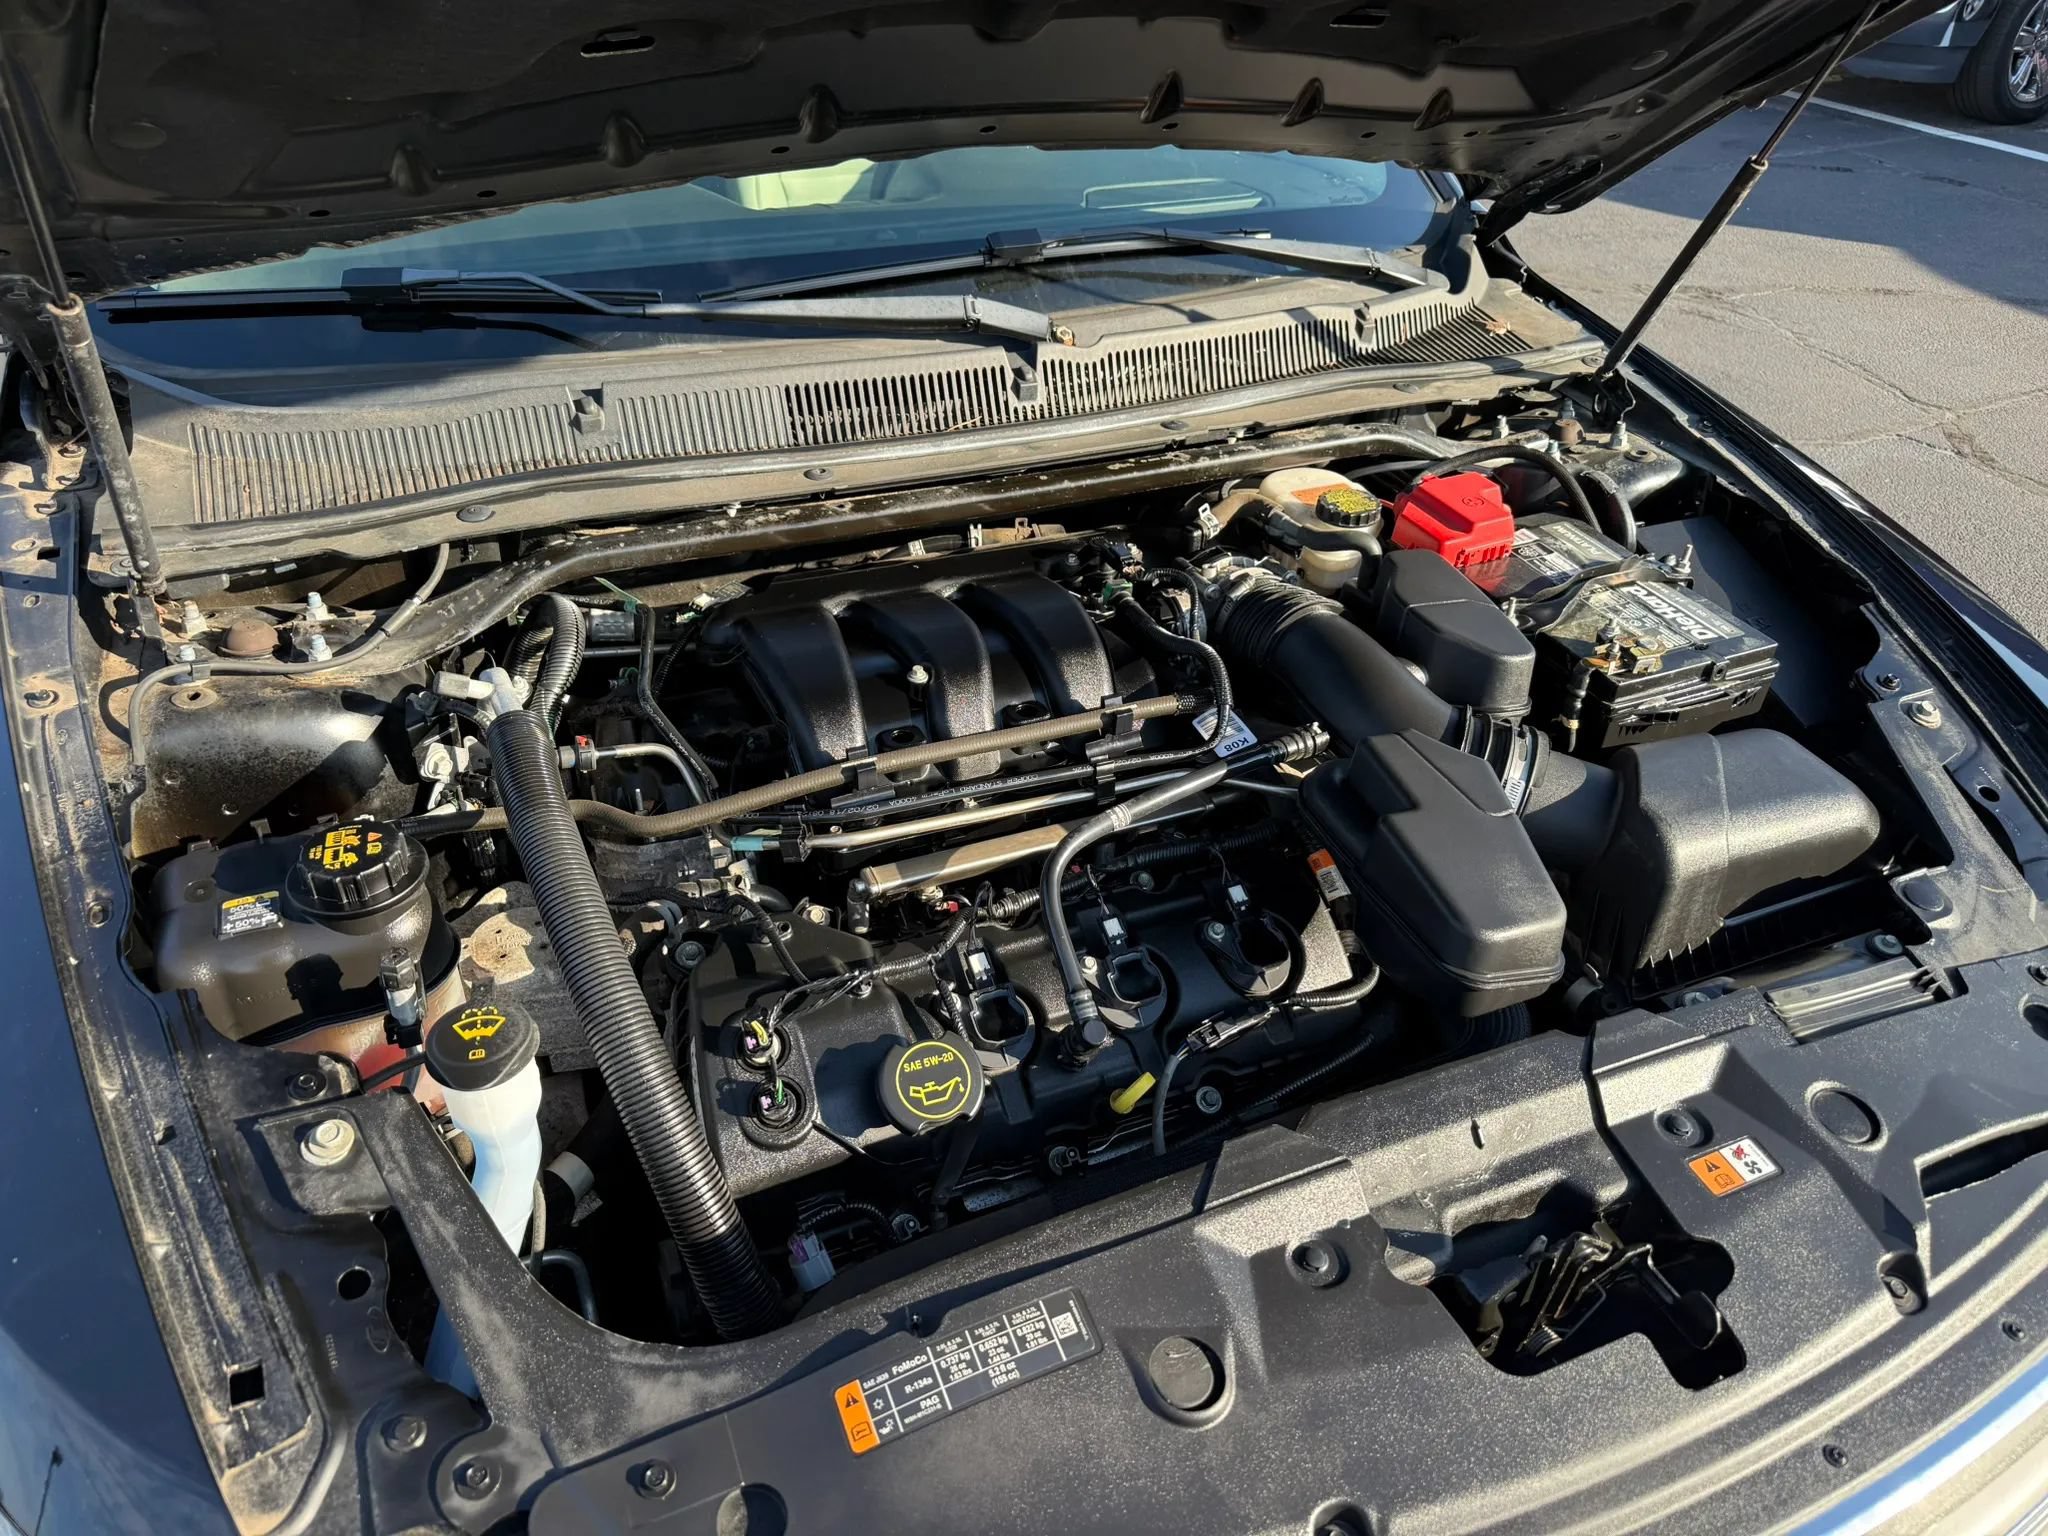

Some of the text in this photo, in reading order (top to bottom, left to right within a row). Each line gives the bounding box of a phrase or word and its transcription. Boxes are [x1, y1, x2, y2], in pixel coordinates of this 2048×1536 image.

[1621, 583, 1719, 640] DieHard
[1223, 736, 1249, 753] K08
[1006, 773, 1039, 785] COOPER
[959, 779, 1003, 794] STANDARD
[888, 796, 918, 807] 4000A
[828, 803, 880, 816] 02/02/18
[235, 917, 261, 929] 50%
[903, 1051, 955, 1073] SAE 5W-20
[1015, 1320, 1046, 1337] 0.822 kg
[1033, 1330, 1042, 1338] oz
[978, 1335, 1008, 1352] 0.652 kg
[1037, 1336, 1049, 1344] lbs
[996, 1345, 1005, 1353] oz
[1000, 1352, 1011, 1360] lbs
[891, 1354, 928, 1375] FoMoCo
[940, 1351, 971, 1368] 0.737 kg
[949, 1361, 967, 1373] 26 oz
[962, 1368, 973, 1376] lbs
[988, 1366, 1000, 1378] 5.2
[1006, 1361, 1016, 1370] oz
[904, 1376, 933, 1394] R-134a
[991, 1368, 1020, 1388] (155 cc)
[919, 1395, 940, 1409] PAG
